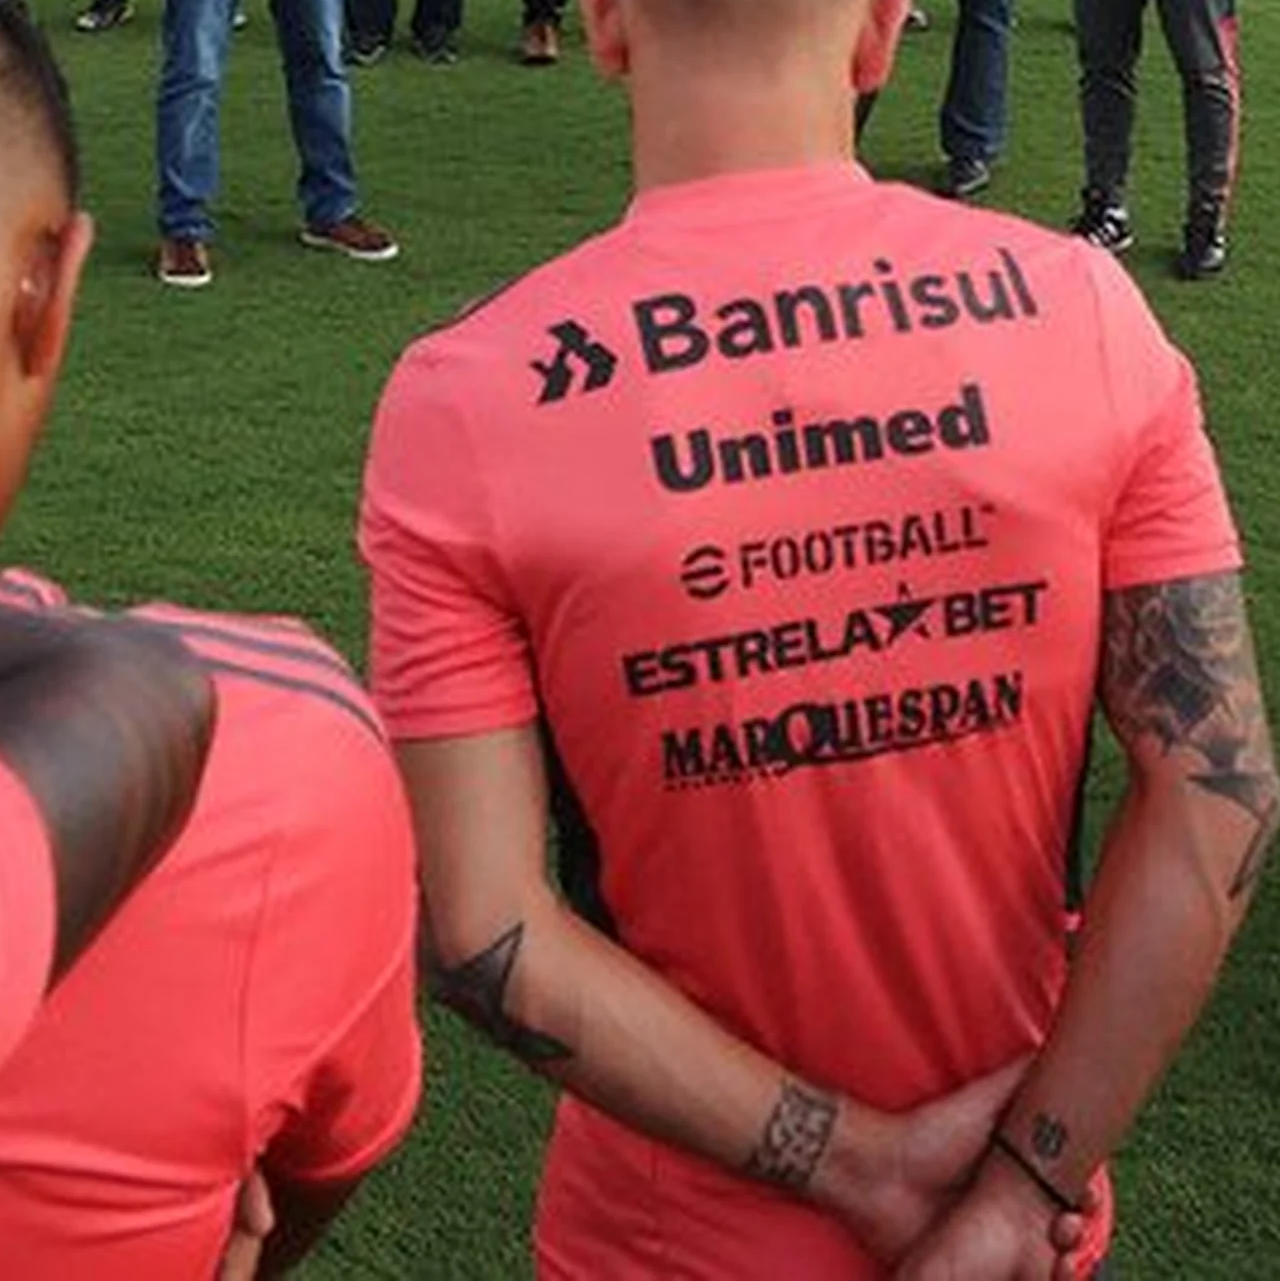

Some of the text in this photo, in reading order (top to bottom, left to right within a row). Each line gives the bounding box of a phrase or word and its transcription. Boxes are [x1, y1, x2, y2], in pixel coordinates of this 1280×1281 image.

[632, 246, 1038, 374] Banrisul
[651, 384, 991, 493] Unimed
[622, 580, 1048, 698] ESTRELA BET
[660, 671, 1024, 781] MARQUESPAN
